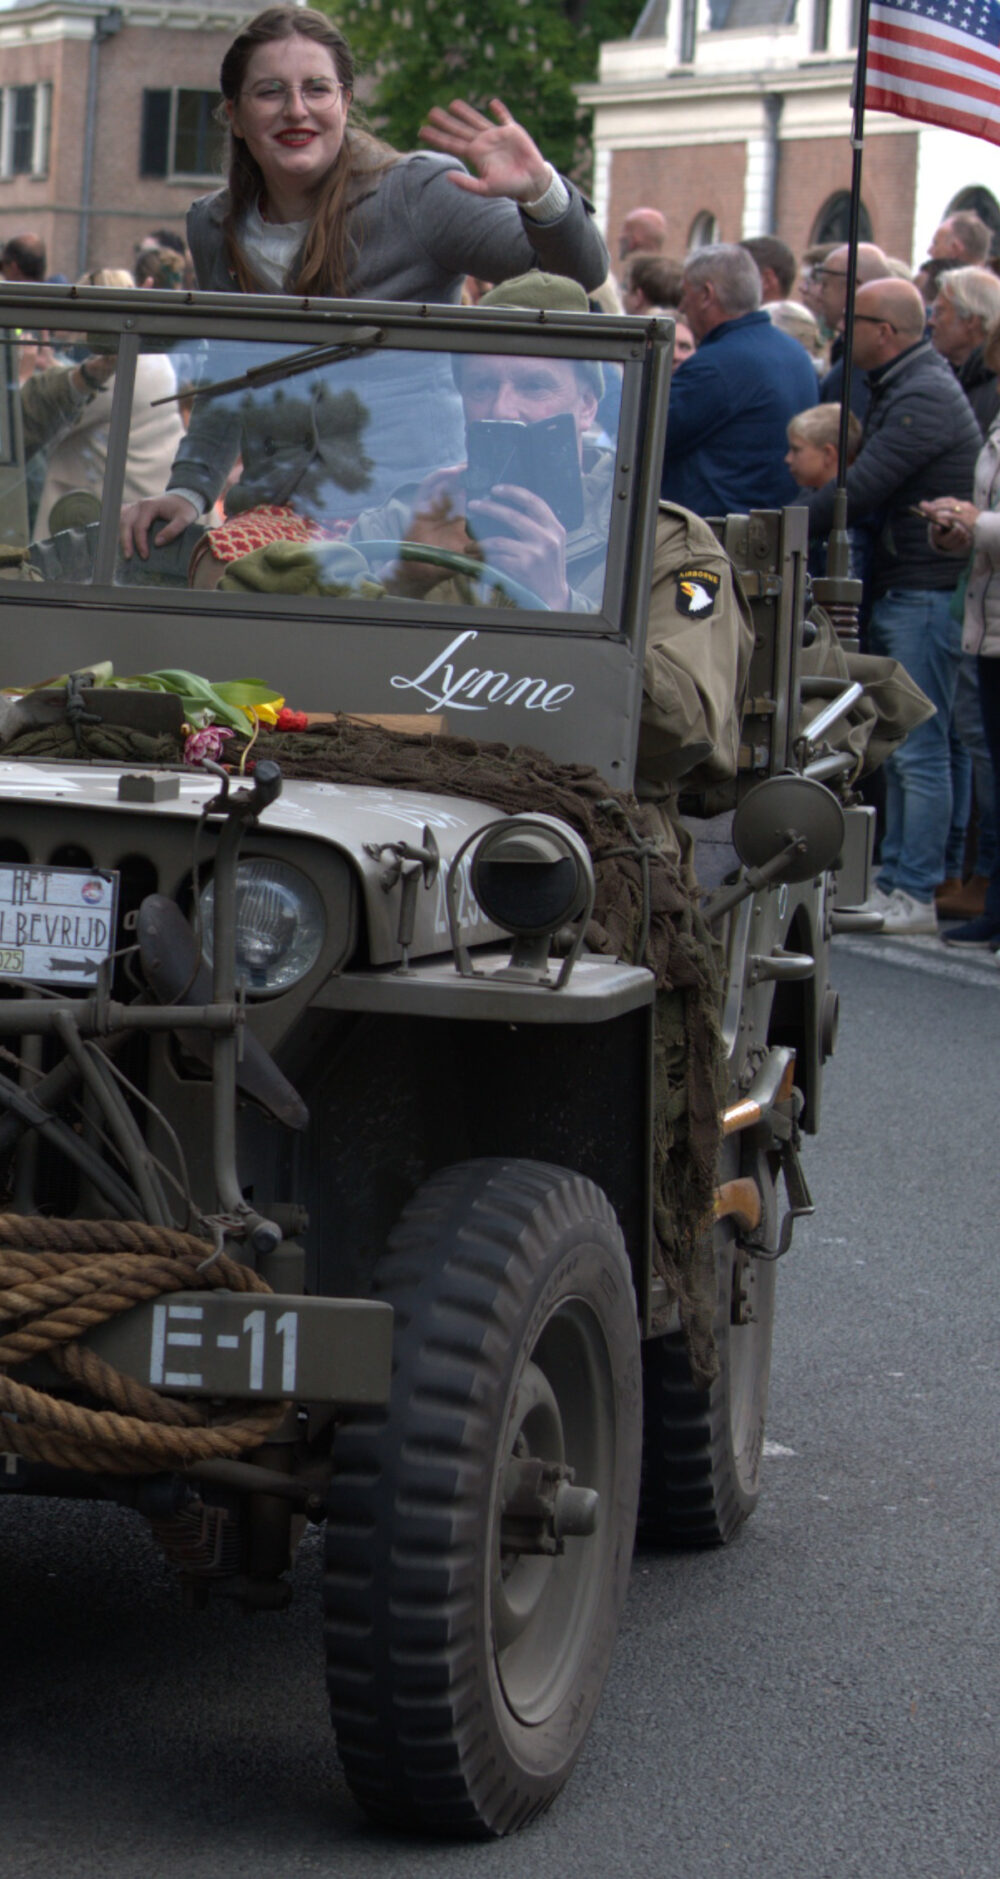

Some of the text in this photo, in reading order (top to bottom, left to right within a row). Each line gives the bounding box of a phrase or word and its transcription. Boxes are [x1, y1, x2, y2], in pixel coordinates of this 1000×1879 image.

[679, 569, 719, 584] AIRBORNE
[390, 630, 575, 713] Lynne
[12, 870, 53, 906] HET
[16, 911, 107, 948] BEVRIJD
[150, 1304, 298, 1392] E-11
